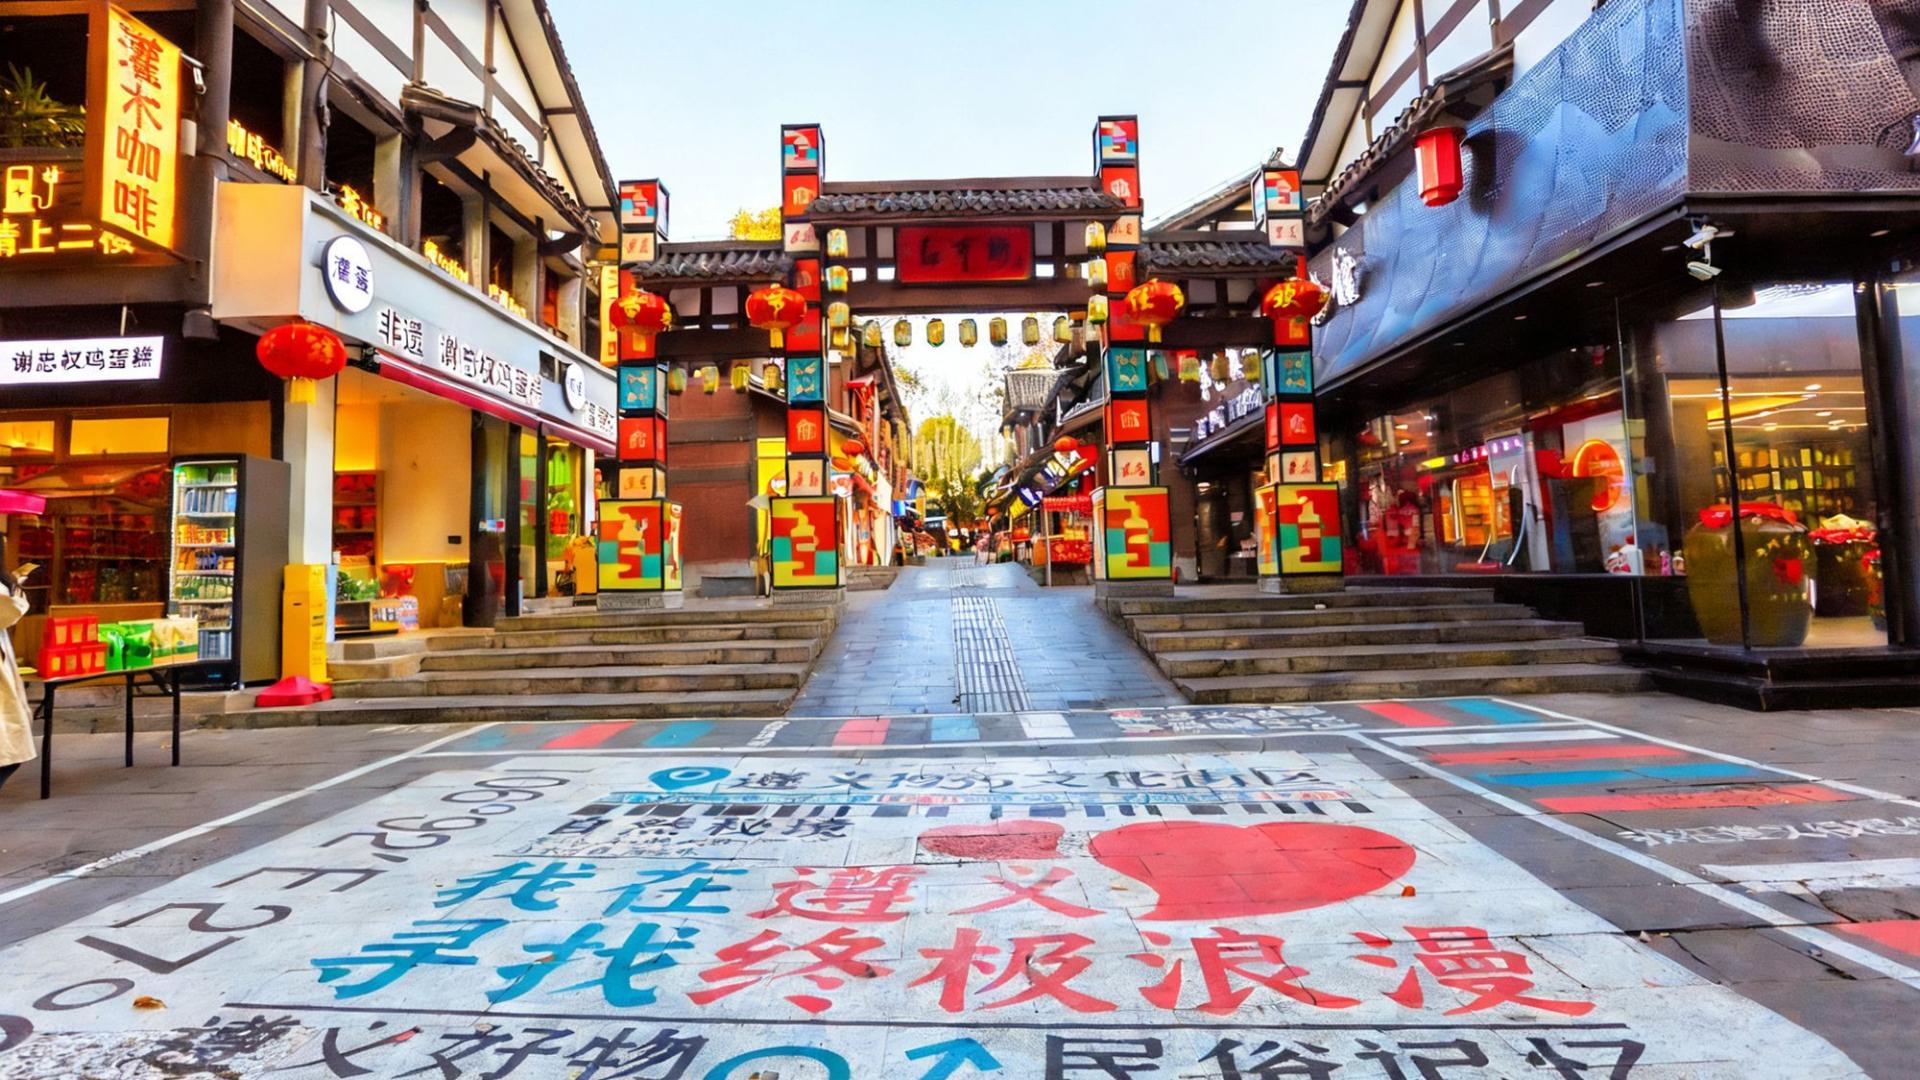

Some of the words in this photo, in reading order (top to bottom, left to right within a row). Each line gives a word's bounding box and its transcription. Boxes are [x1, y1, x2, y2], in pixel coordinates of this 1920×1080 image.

[434, 861, 1107, 923] 我在遵义
[311, 919, 1596, 1016] 寻找终极浪漫
